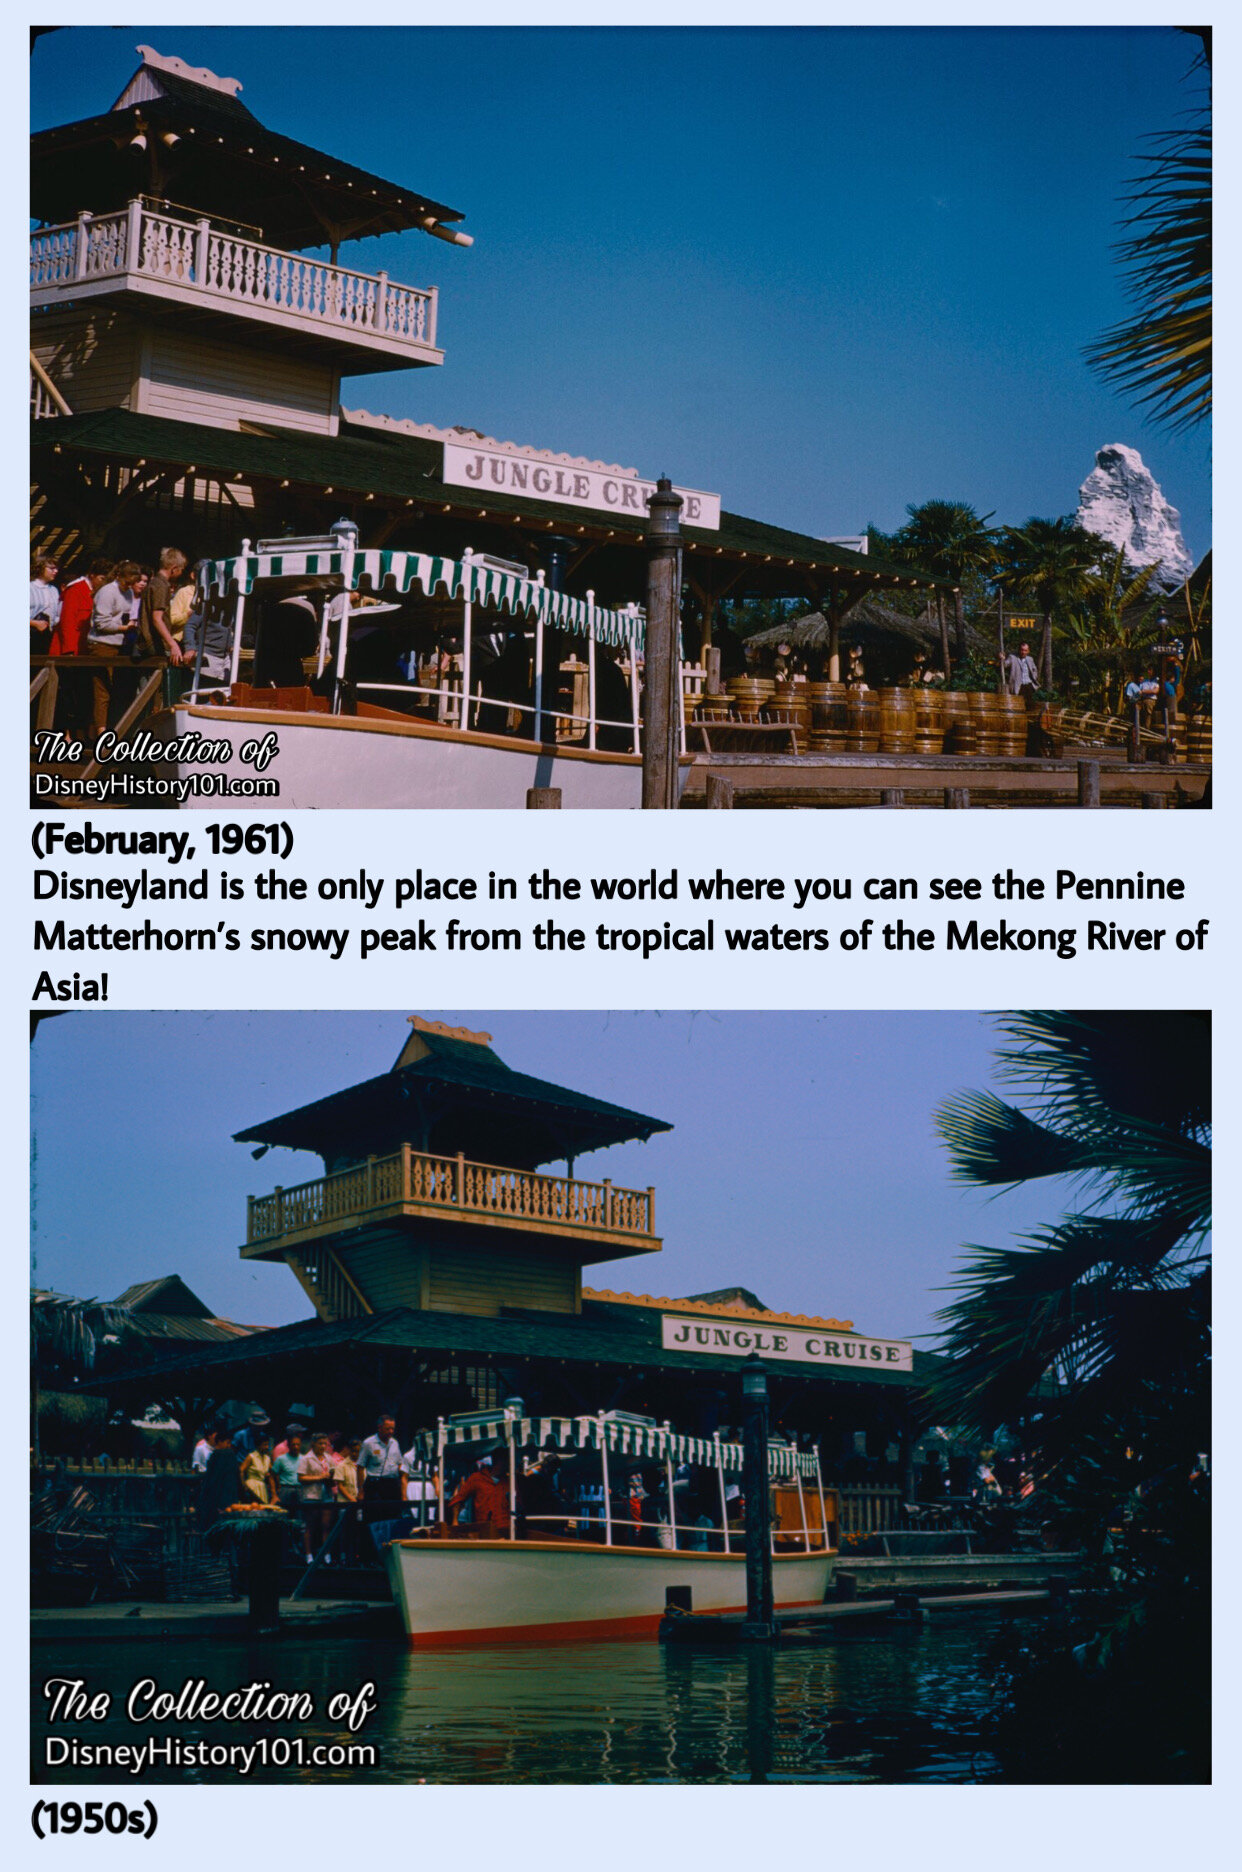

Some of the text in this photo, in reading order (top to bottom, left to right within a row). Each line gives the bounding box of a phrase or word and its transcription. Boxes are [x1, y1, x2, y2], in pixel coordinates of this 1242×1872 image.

[465, 455, 590, 500] JUNGLE
[1010, 618, 1036, 628] EXIT
[674, 1325, 901, 1363] JUNGLE CRUISE
